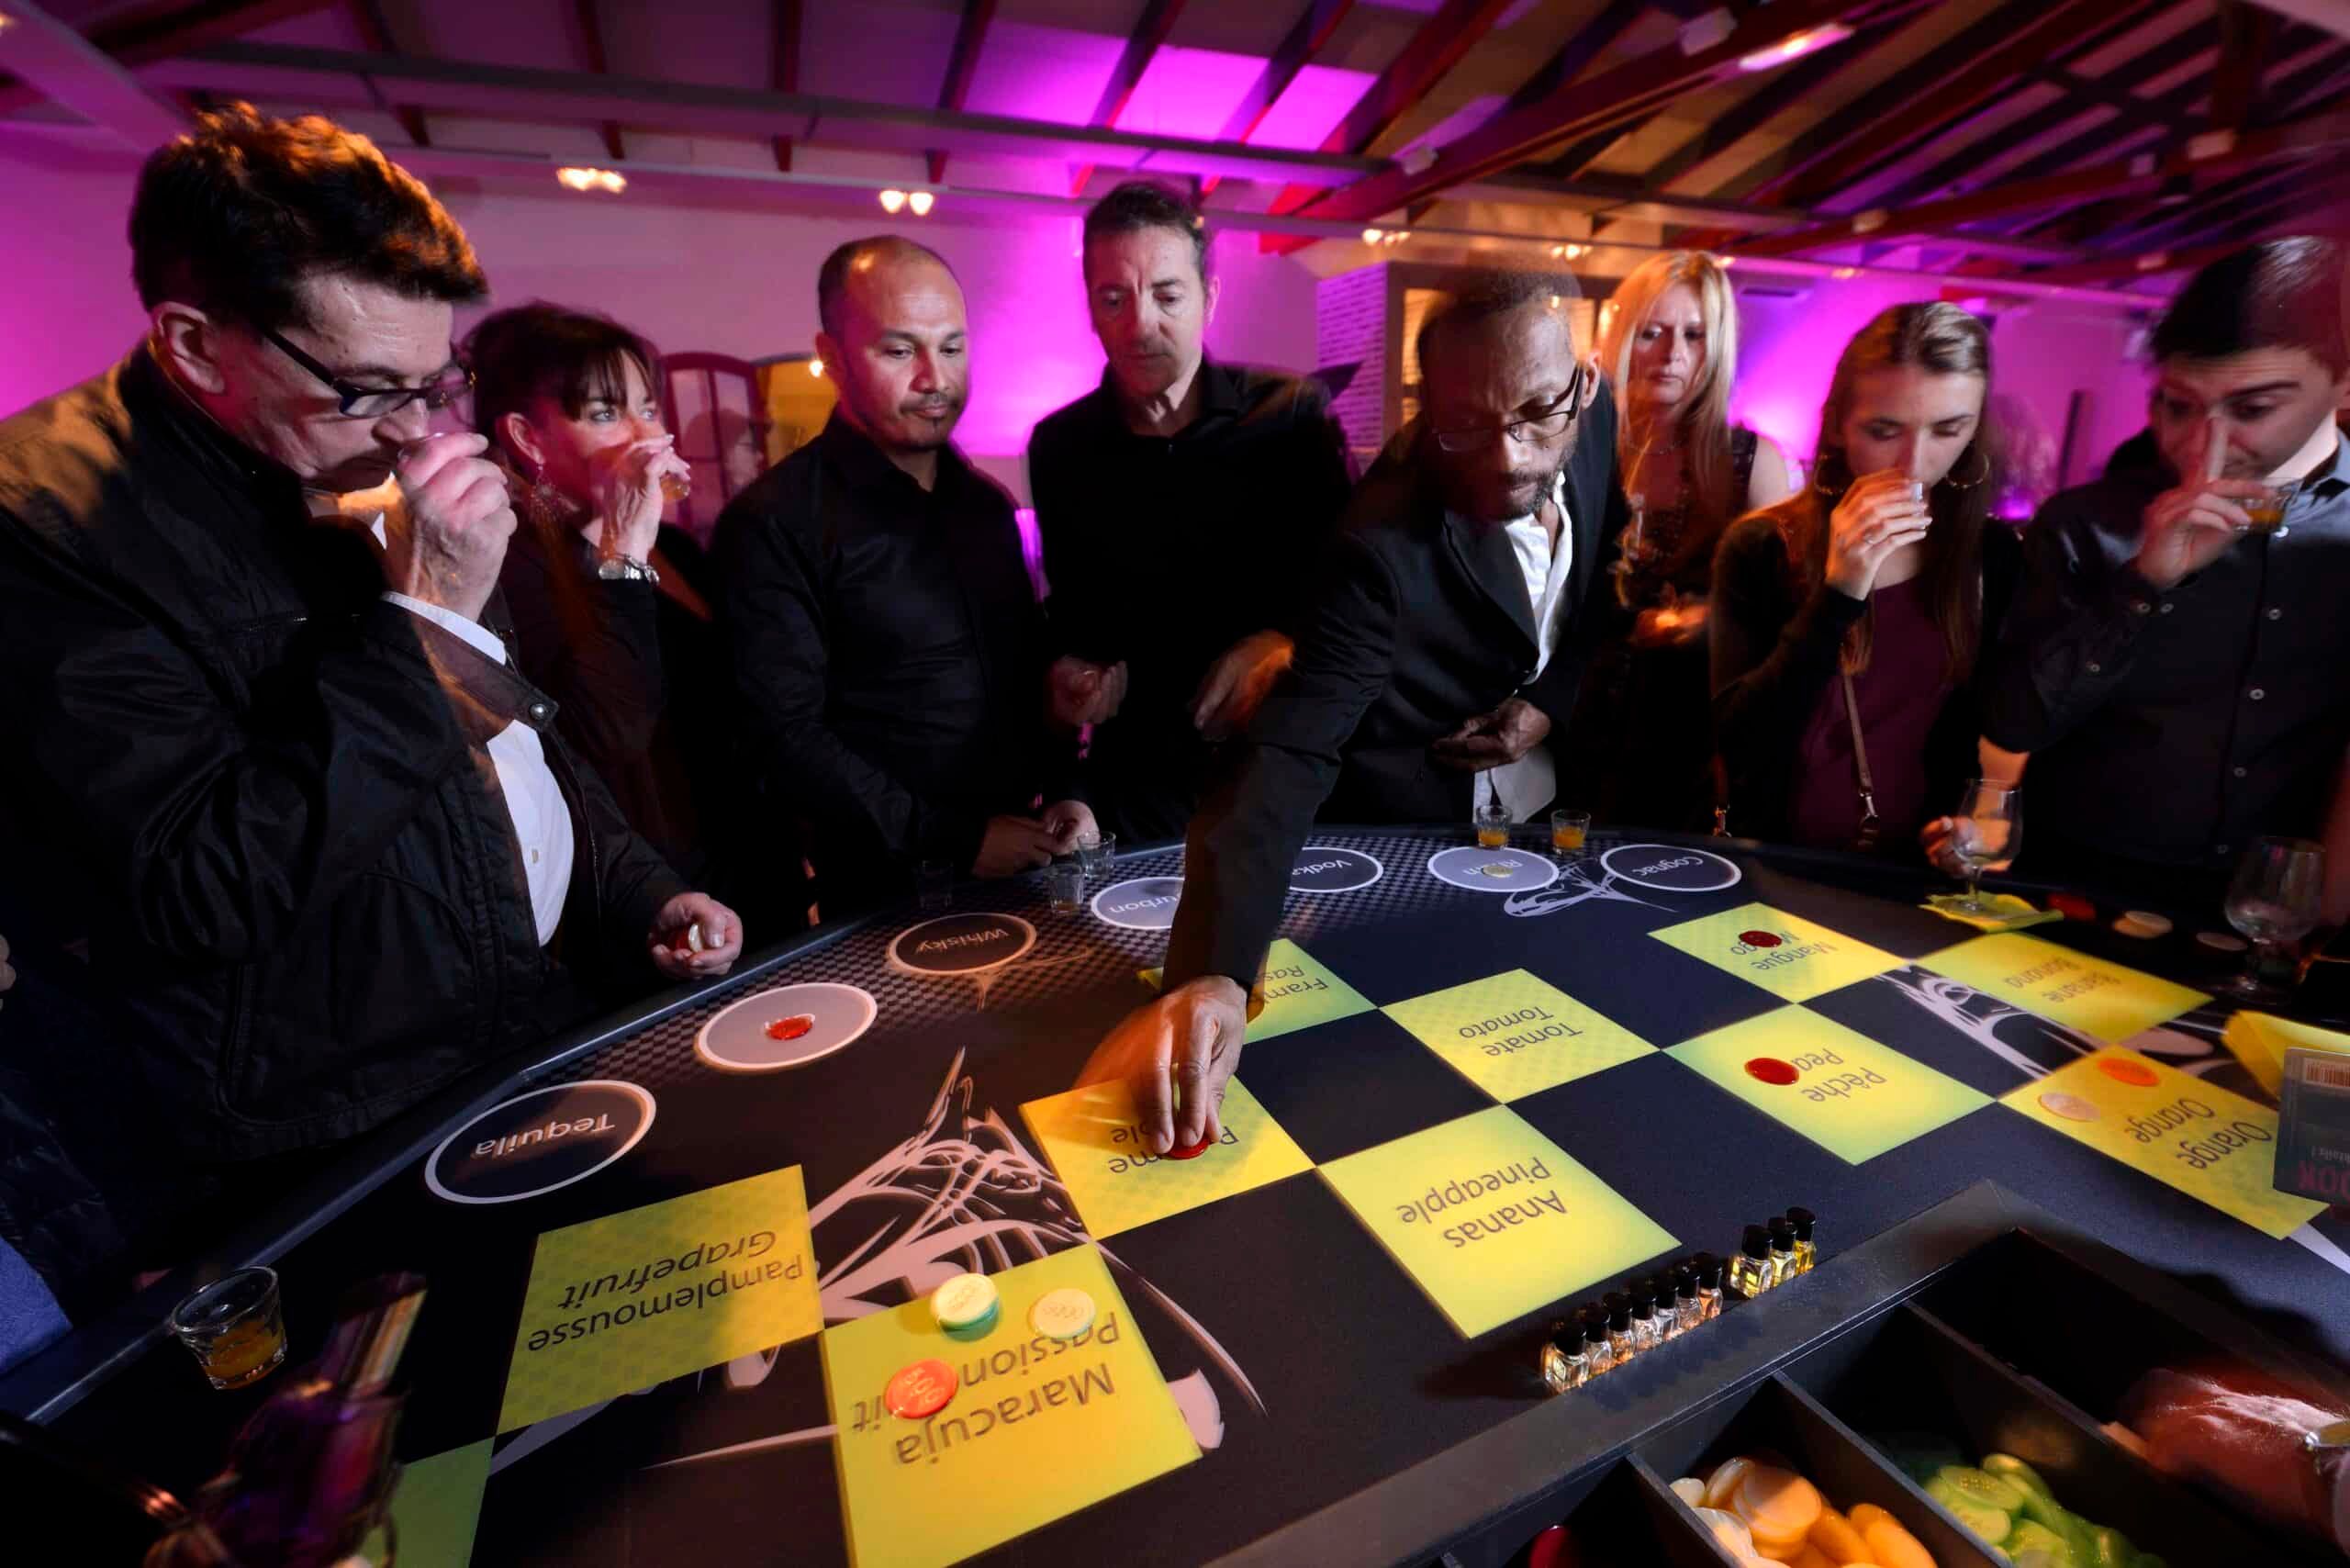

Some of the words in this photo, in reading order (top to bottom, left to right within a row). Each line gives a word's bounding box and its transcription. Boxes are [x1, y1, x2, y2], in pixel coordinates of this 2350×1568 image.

[1632, 855, 1704, 877] Cognac
[1108, 893, 1179, 914] urbon
[915, 927, 1010, 954] Whisky
[1730, 930, 1800, 956] Mgo
[1751, 941, 1839, 970] Mangue
[1459, 1005, 1554, 1039] Tomato
[1481, 1022, 1583, 1057] Tomate
[1792, 1047, 1844, 1072] Pea
[1801, 1067, 1888, 1103] Pêche
[476, 1113, 616, 1158] Tequila
[2125, 1098, 2215, 1144] Orange
[2176, 1120, 2273, 1170] Orange
[1395, 1157, 1551, 1225] Pineapple
[1443, 1190, 1568, 1249] Ananas
[557, 1230, 778, 1310] Grapefruit
[528, 1253, 804, 1352] Pamplemousse
[962, 1311, 1120, 1387] Passion
[895, 1362, 1116, 1464] Maracuja
